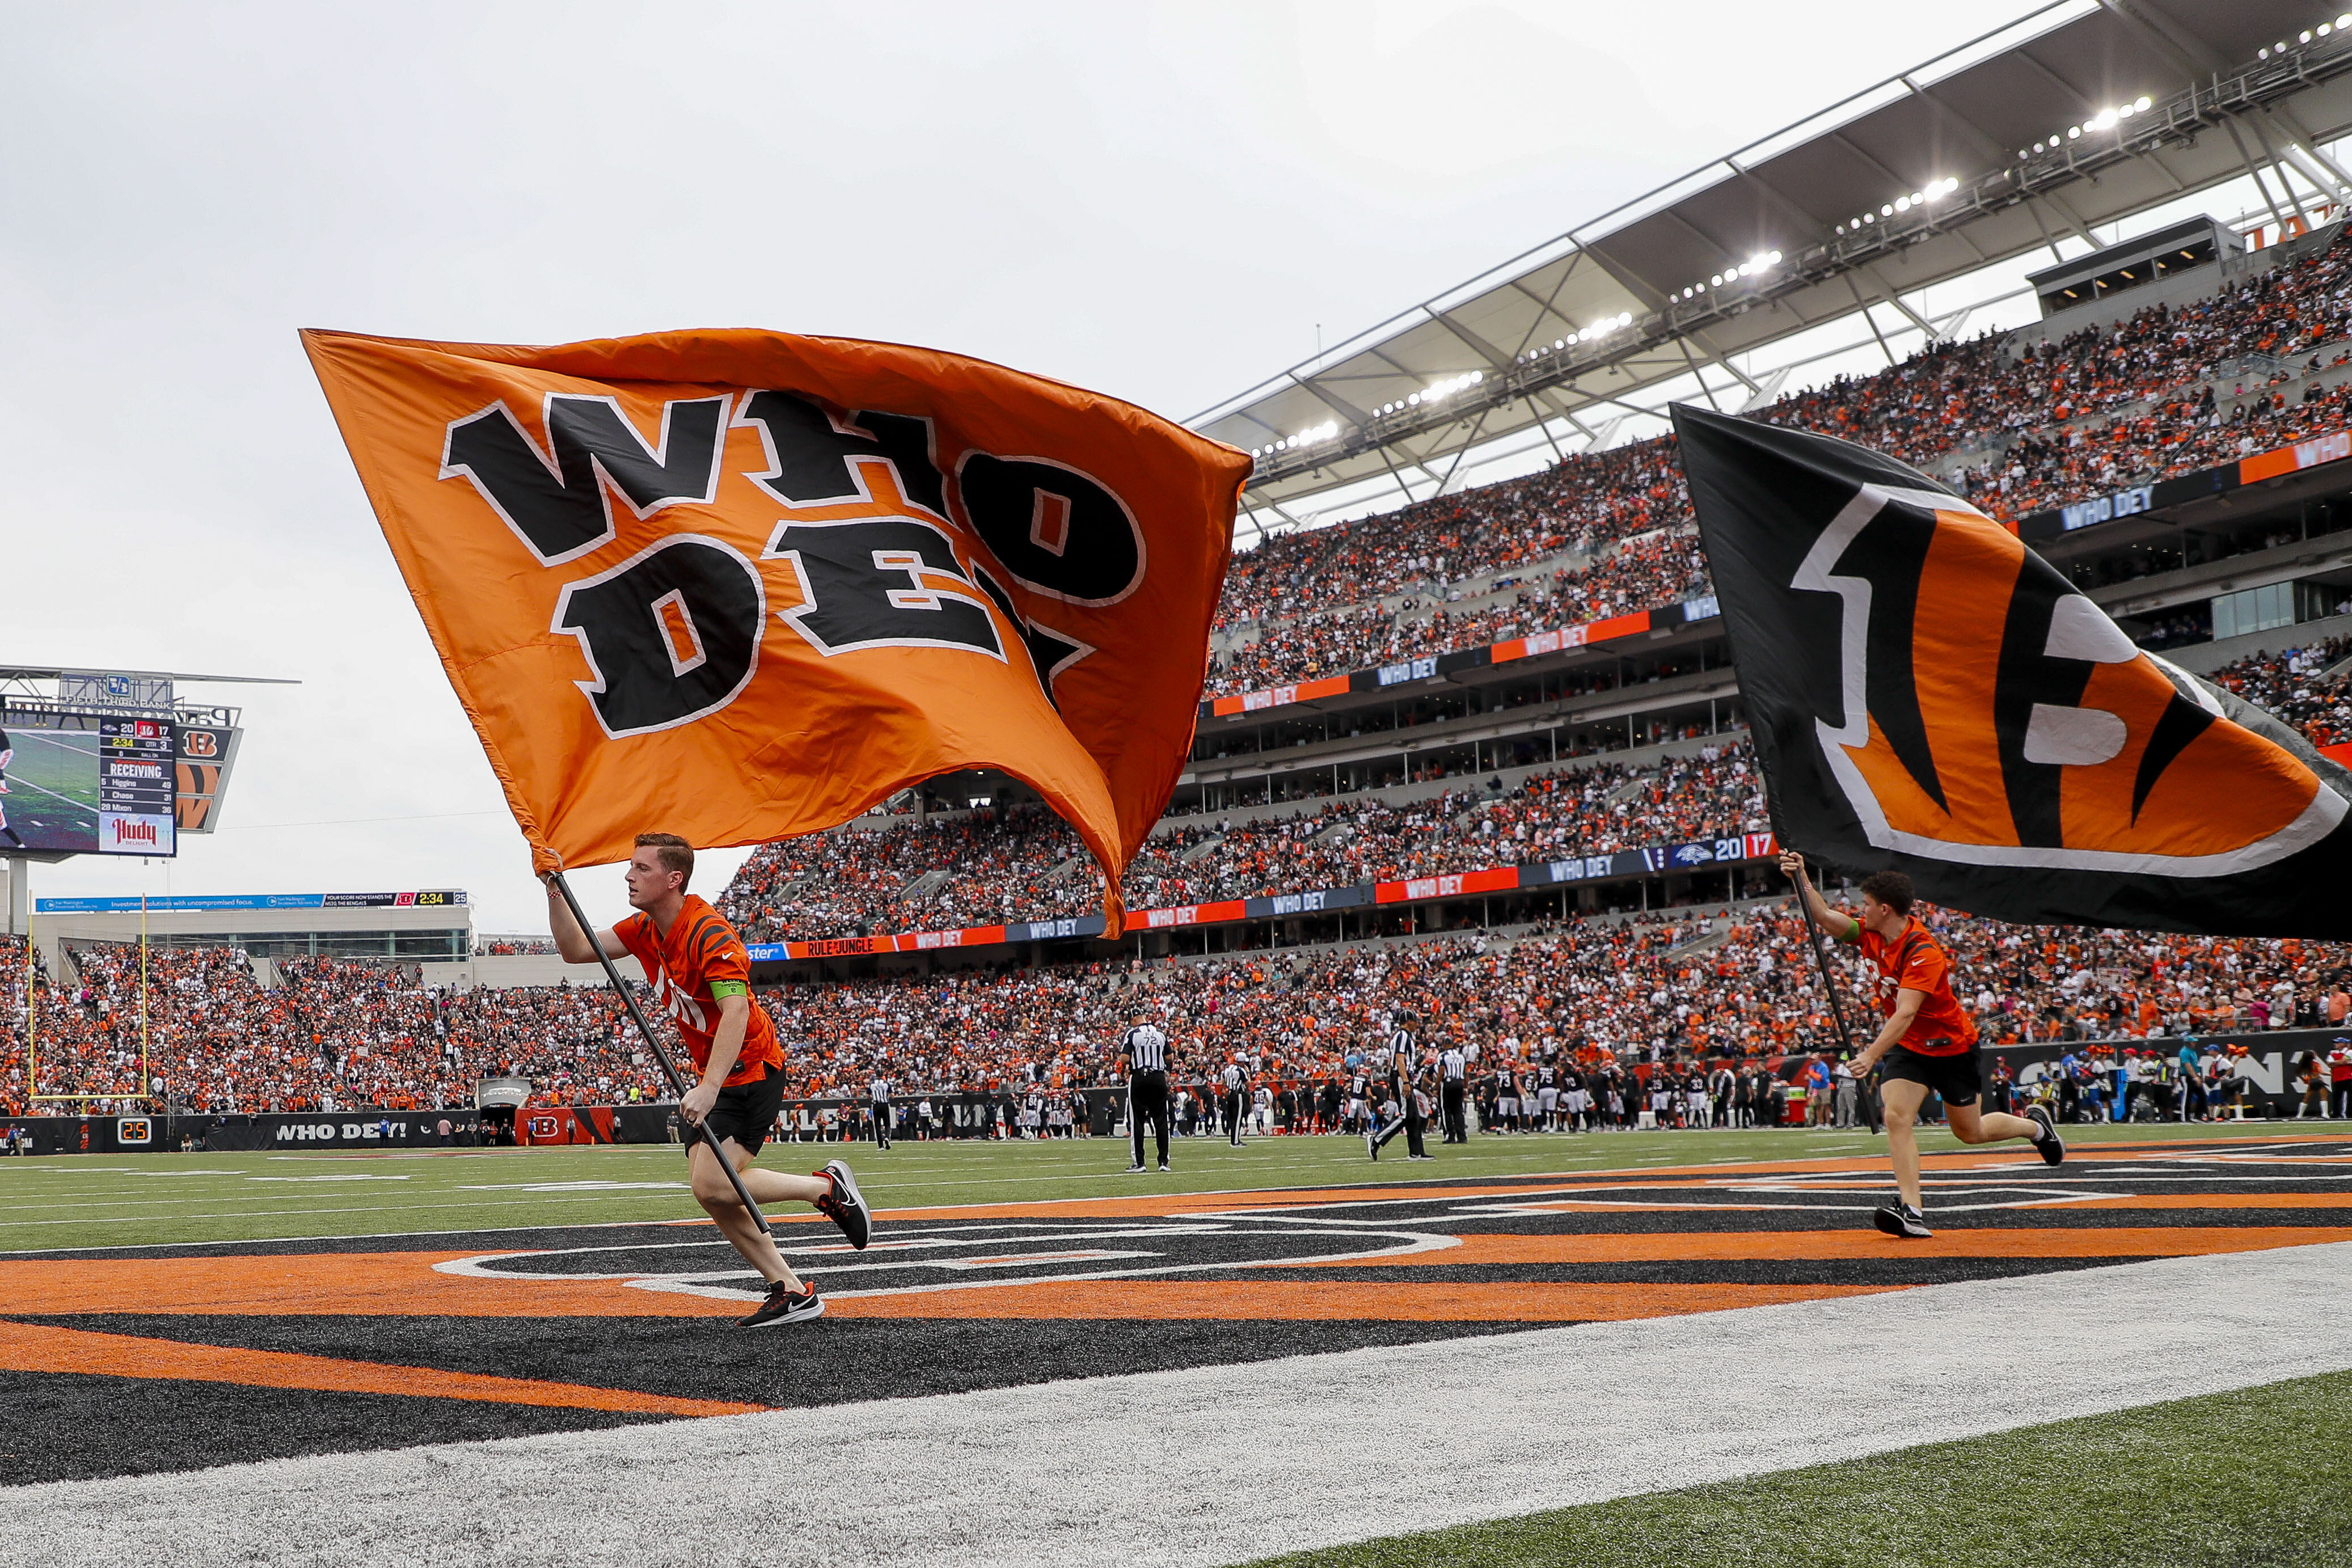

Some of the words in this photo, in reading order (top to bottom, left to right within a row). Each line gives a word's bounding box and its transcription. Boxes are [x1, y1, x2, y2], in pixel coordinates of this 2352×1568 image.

[438, 387, 1147, 608] WHO
[2063, 497, 2112, 530] WHO
[2114, 485, 2154, 517] DEY
[1525, 632, 1559, 656] WHO
[1560, 625, 1588, 648] DEY
[1378, 663, 1411, 686] WHO
[1412, 657, 1438, 679] DEY
[66, 695, 98, 705] FIFTH
[103, 698, 137, 707] THIRD
[140, 699, 171, 709] BANK
[1243, 690, 1272, 711] WHO
[1274, 685, 1298, 704] DEY
[120, 723, 134, 733] 20
[158, 726, 169, 736] 17
[112, 738, 134, 747] 2:34
[160, 741, 167, 750] 3
[110, 762, 162, 779] RECEIVING
[112, 779, 137, 788] Higgins
[112, 791, 134, 800] Chase
[112, 803, 132, 812] Mixon
[112, 818, 157, 847] Hudy
[1715, 837, 1741, 861] 20
[1751, 833, 1772, 856] 17
[1549, 860, 1584, 882] WHO
[1585, 855, 1613, 878] DEY
[1405, 878, 1436, 900] WHO
[1439, 875, 1463, 895] DEY
[420, 893, 444, 904] 2:34
[455, 894, 466, 903] 25
[1273, 894, 1302, 914] WHO
[1304, 891, 1326, 912] DEY
[1147, 909, 1175, 927] WHO
[1177, 906, 1198, 924] DEY
[1029, 922, 1055, 939] WHO
[1057, 918, 1077, 936] DEY
[916, 931, 941, 948] WHO
[943, 929, 962, 946] DEY
[808, 941, 833, 956] RULE
[836, 939, 873, 954] JUNGLE
[1143, 1037, 1157, 1045] 72
[1539, 1071, 1553, 1084] 75
[1353, 1080, 1363, 1094] 10
[123, 1122, 146, 1139] 25
[276, 1124, 335, 1140] WHO
